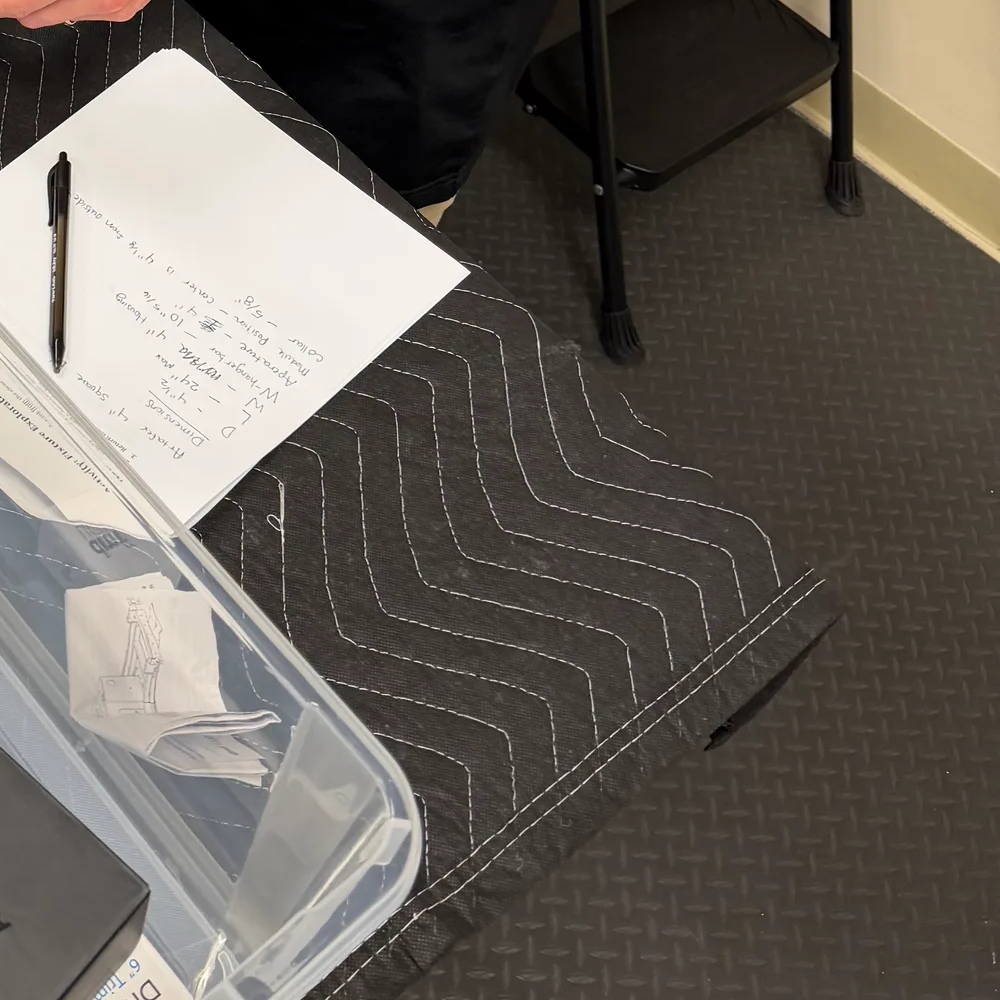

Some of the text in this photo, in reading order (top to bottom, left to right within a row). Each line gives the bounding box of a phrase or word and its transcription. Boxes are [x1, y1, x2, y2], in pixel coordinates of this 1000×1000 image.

[69, 193, 102, 220] outside
[114, 291, 147, 324] Housing
[239, 408, 251, 425] L
[244, 396, 264, 414] W
[144, 397, 204, 447] Dimensions
[220, 424, 236, 439] D
[38, 430, 73, 460] Fixture
